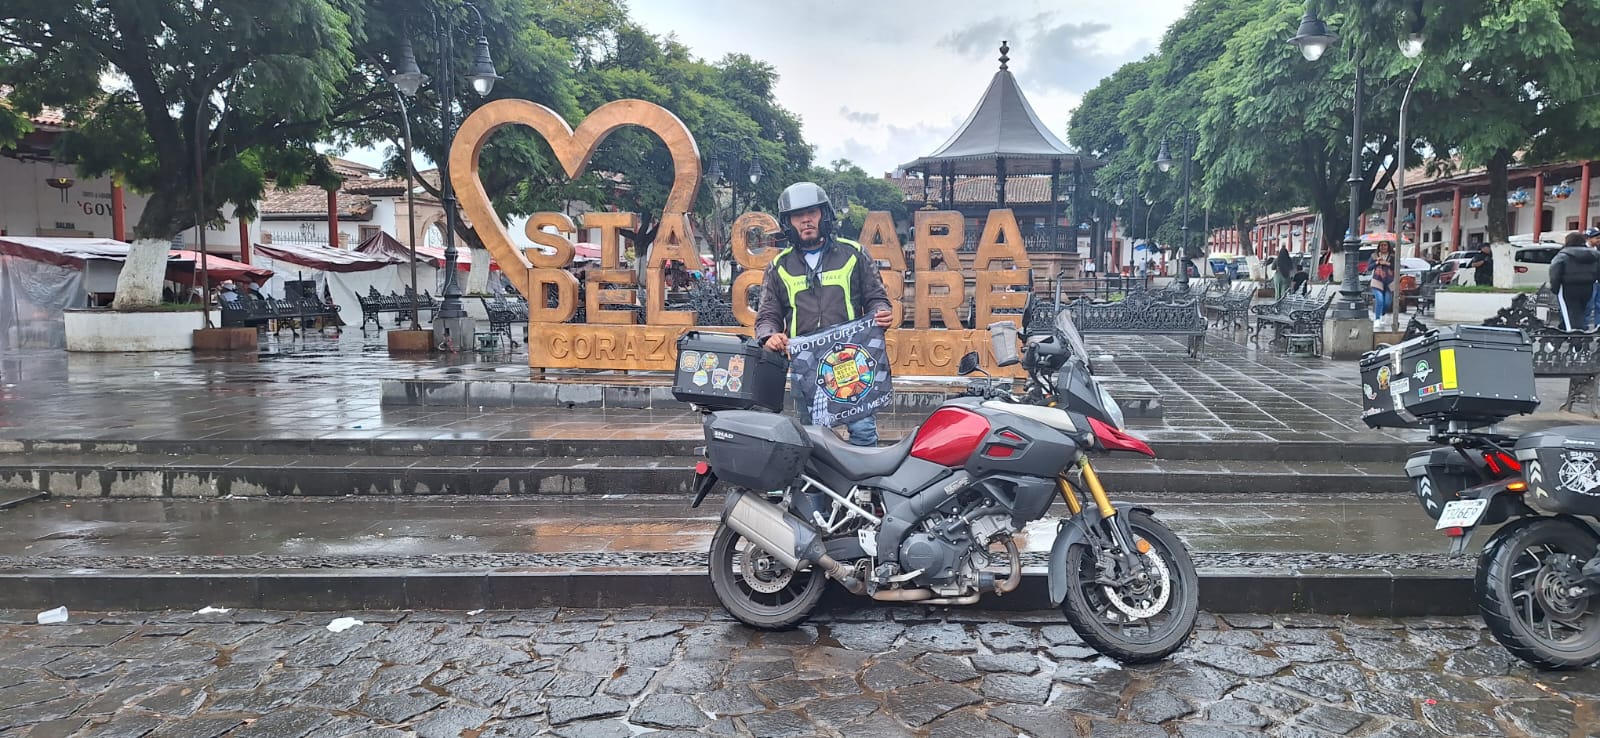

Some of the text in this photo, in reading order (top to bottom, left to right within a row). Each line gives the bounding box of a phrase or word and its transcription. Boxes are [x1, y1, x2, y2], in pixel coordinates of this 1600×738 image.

[525, 208, 1032, 271] STA CARA
[529, 268, 698, 325] DEL
[714, 431, 734, 439] SHAD
